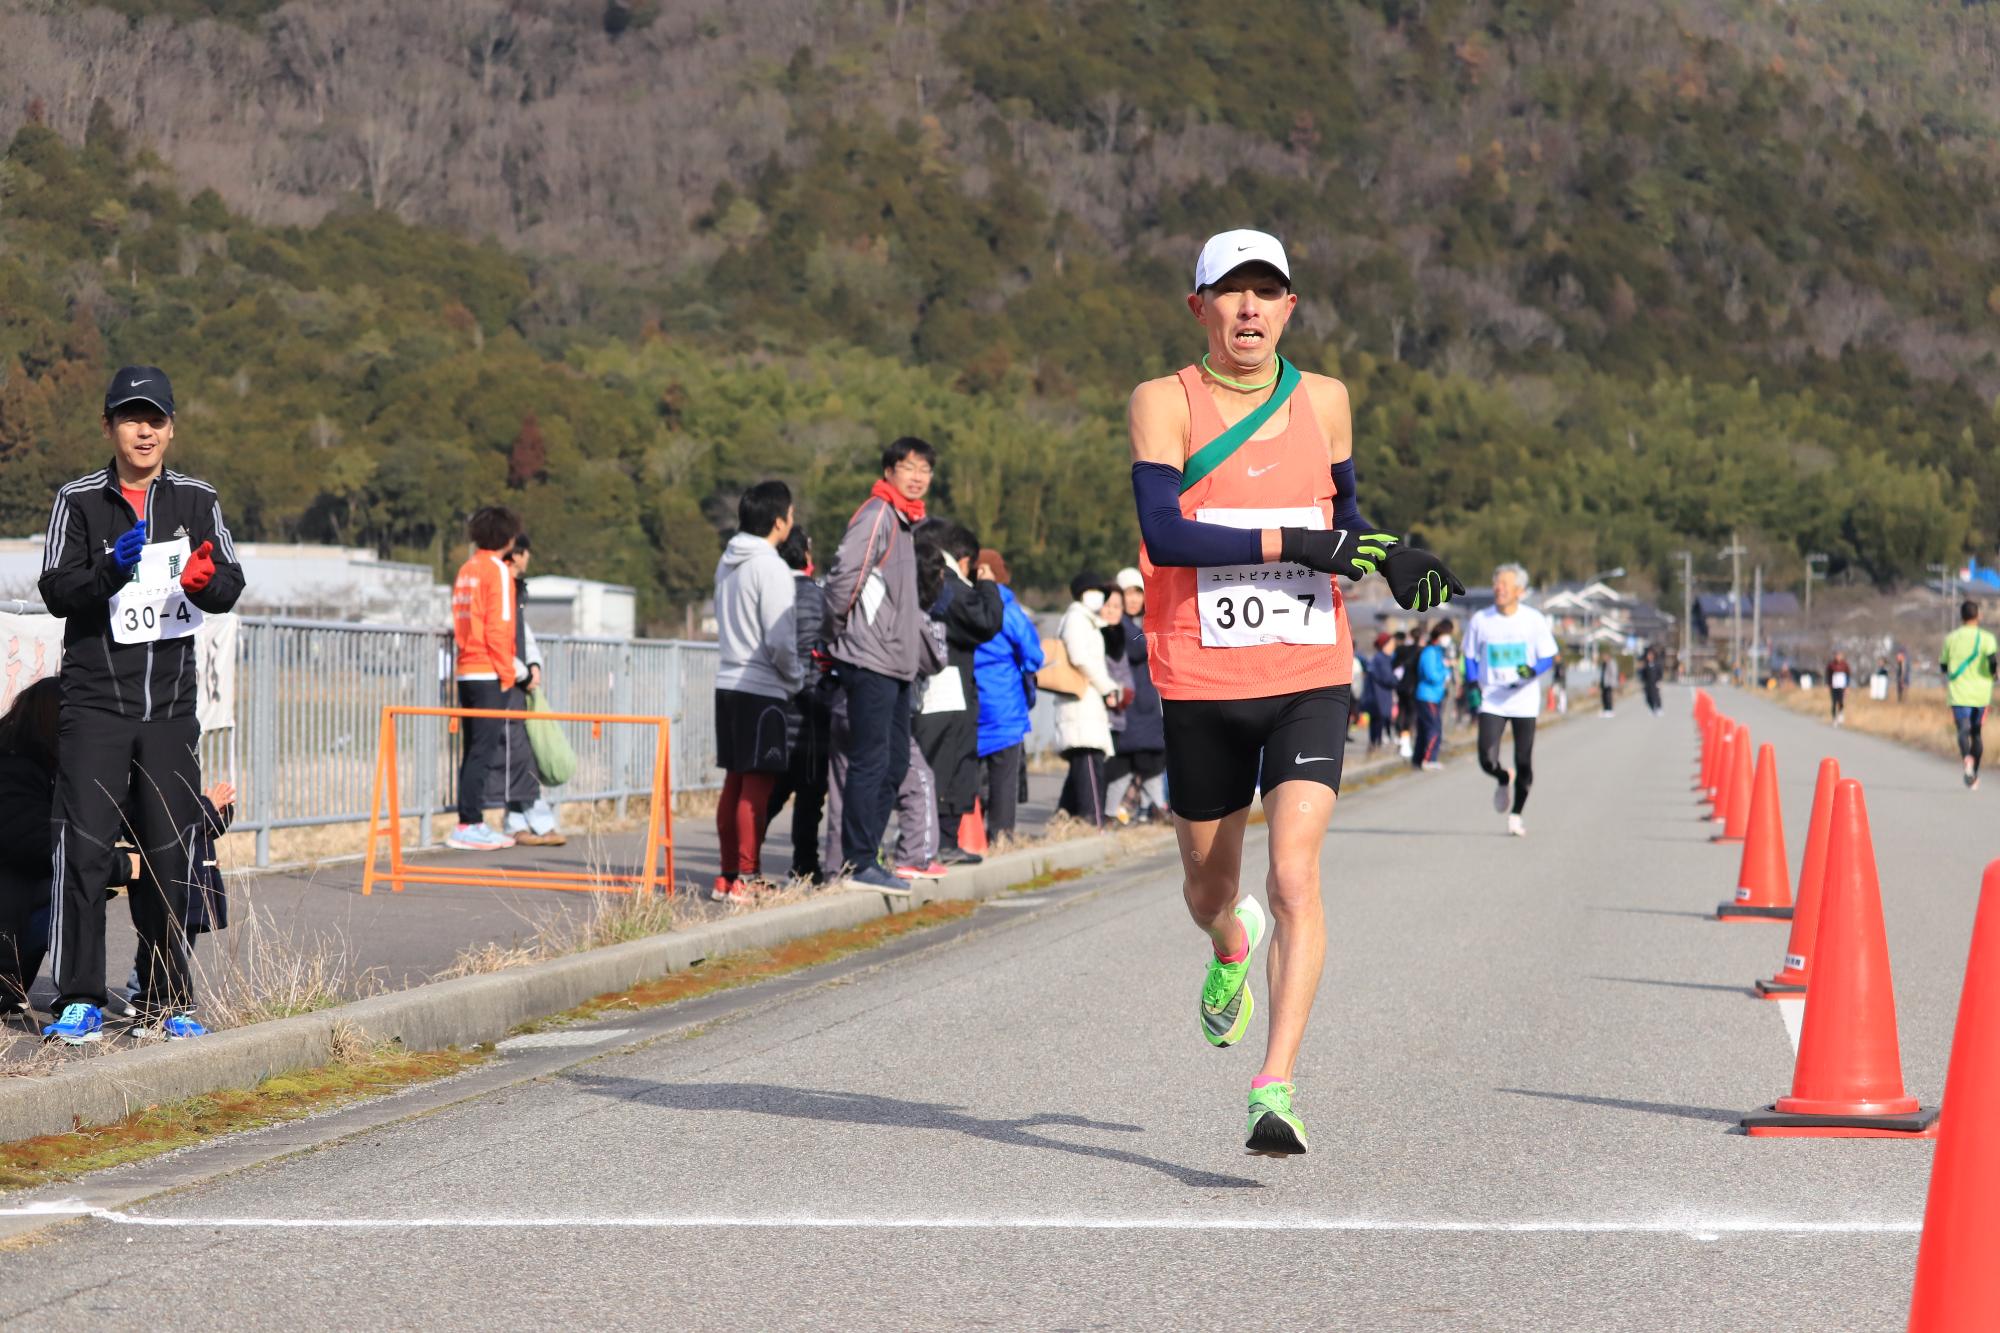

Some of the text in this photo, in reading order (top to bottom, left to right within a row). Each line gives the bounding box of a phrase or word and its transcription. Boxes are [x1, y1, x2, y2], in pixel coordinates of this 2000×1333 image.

[1212, 569, 1316, 582] ユニトピアささやま
[125, 601, 191, 632] 30-4
[1216, 594, 1316, 630] 30-7
